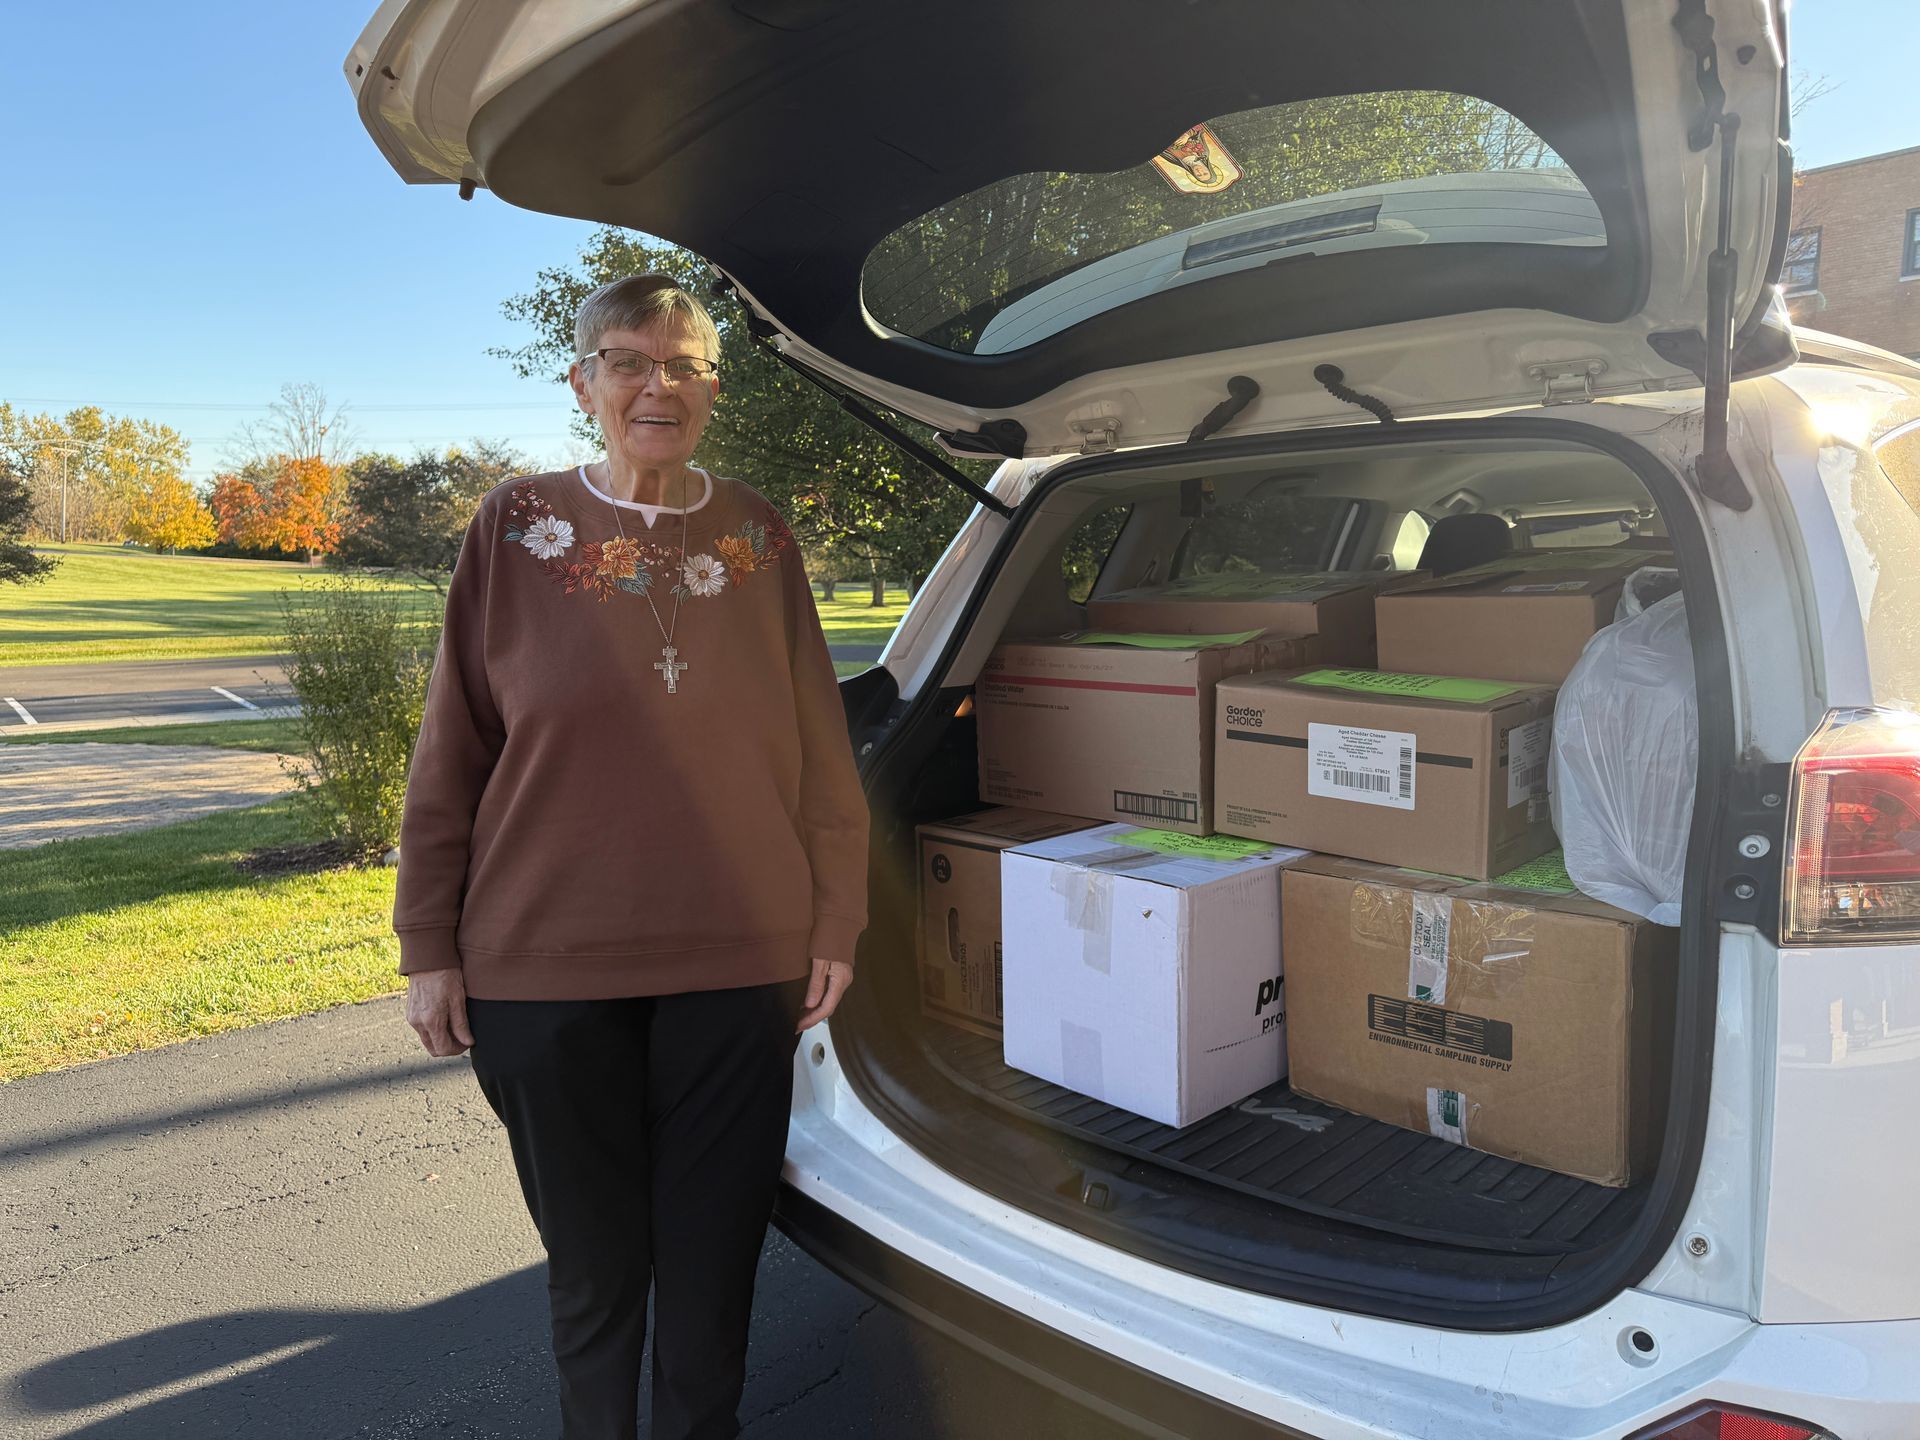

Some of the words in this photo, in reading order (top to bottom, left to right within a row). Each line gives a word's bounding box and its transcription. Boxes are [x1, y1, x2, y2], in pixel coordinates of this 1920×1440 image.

[1226, 705, 1263, 717] Gordon
[1414, 910, 1424, 956] CUSTODY
[1423, 924, 1432, 948] SEAL
[1369, 1031, 1433, 1055] ENVIRONMENTAL
[1434, 1047, 1478, 1065] SAMPLING
[1479, 1057, 1512, 1073] SUPPLY
